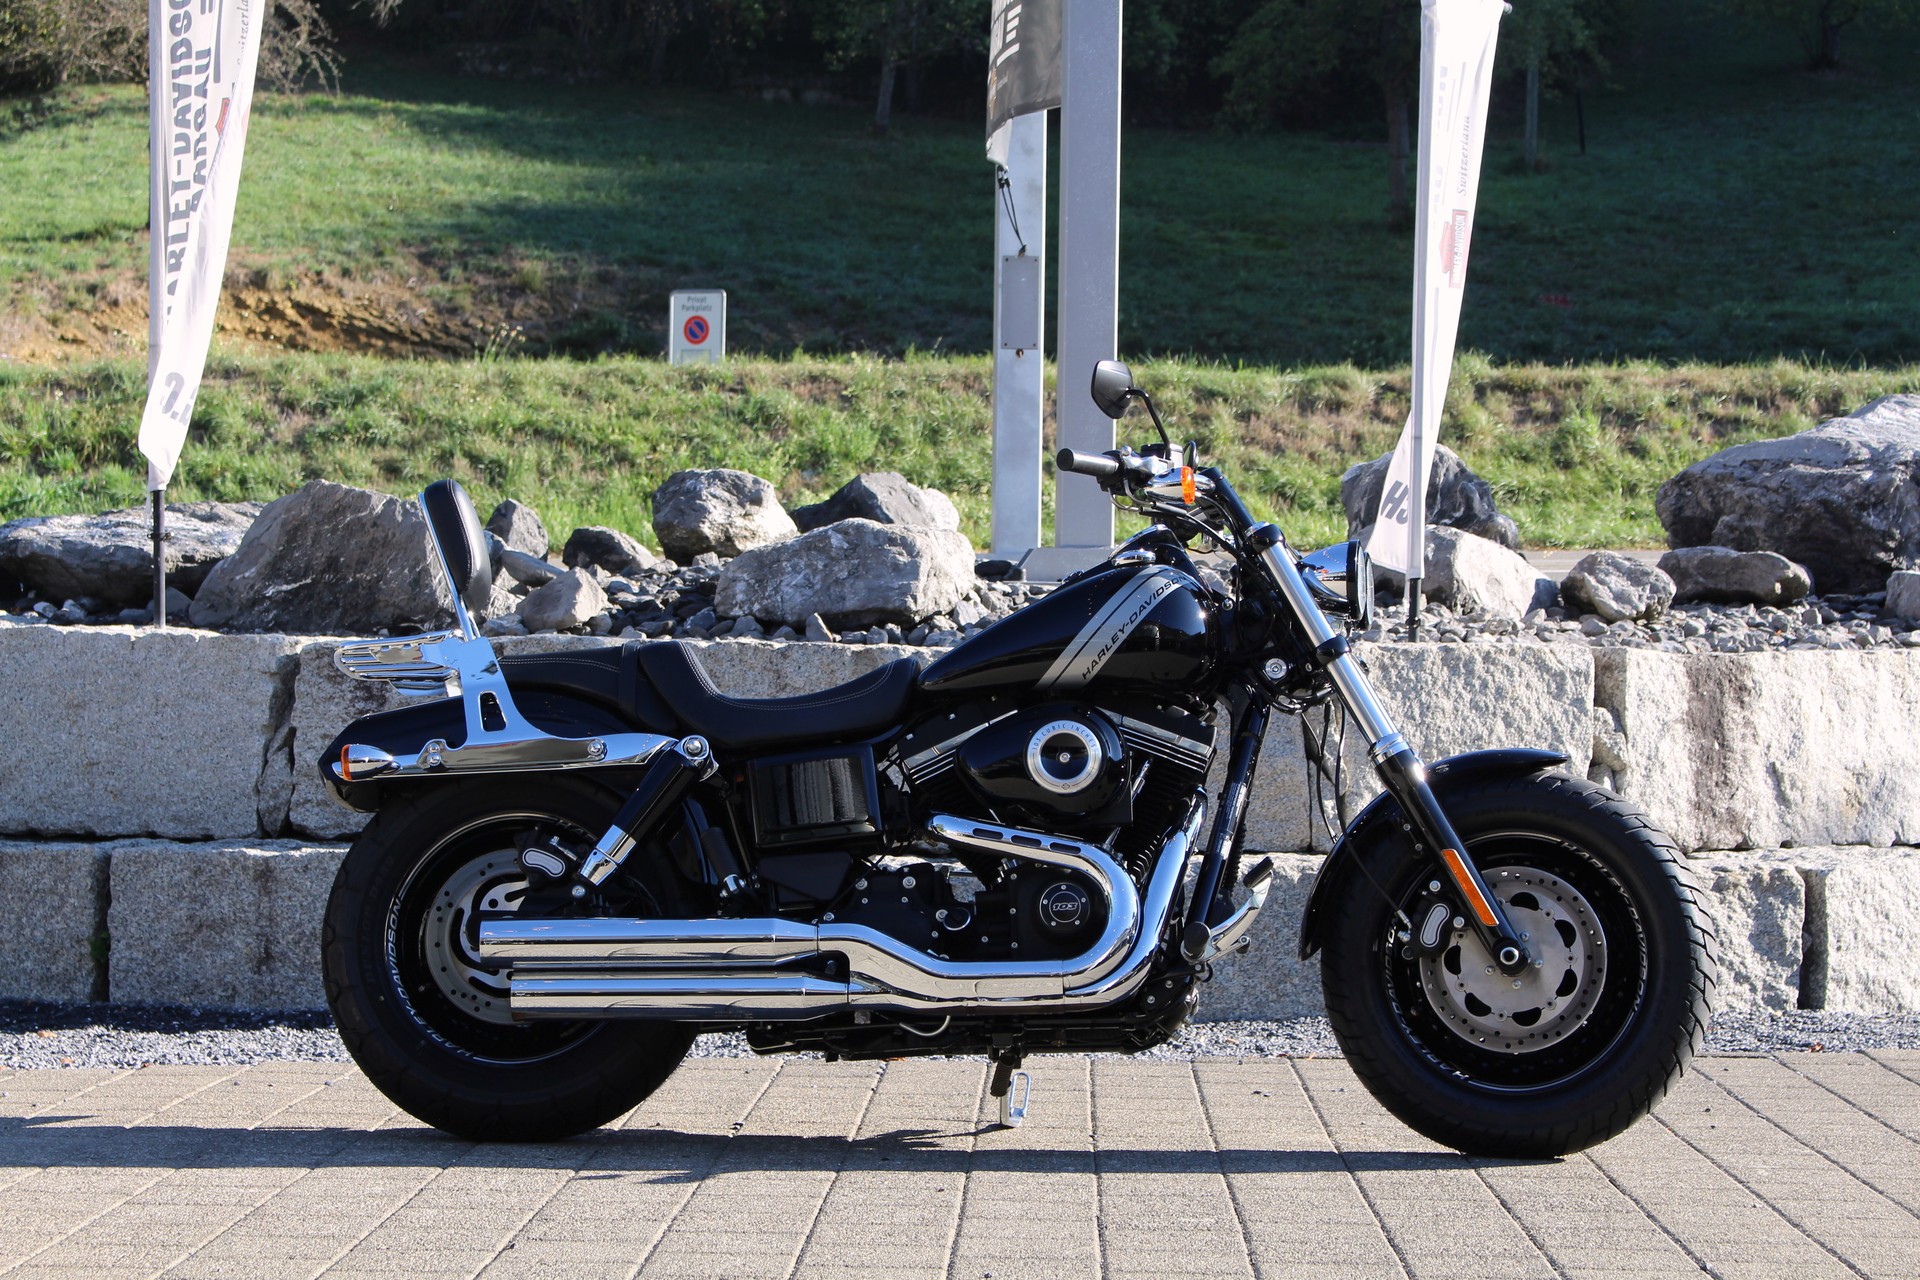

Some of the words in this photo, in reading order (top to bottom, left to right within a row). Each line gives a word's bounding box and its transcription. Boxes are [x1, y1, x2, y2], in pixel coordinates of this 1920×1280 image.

[681, 304, 712, 313] Parkplatz
[1082, 575, 1188, 680] HARLEY-DAVIDSON
[1032, 738, 1041, 750] 103
[1041, 723, 1066, 737] CUBIC
[1071, 724, 1096, 748] INCHES
[1053, 902, 1078, 911] 103
[1561, 841, 1648, 1012] HARLEY-DAVIDSON
[387, 898, 474, 1057] HARLEY-DAVIDSON
